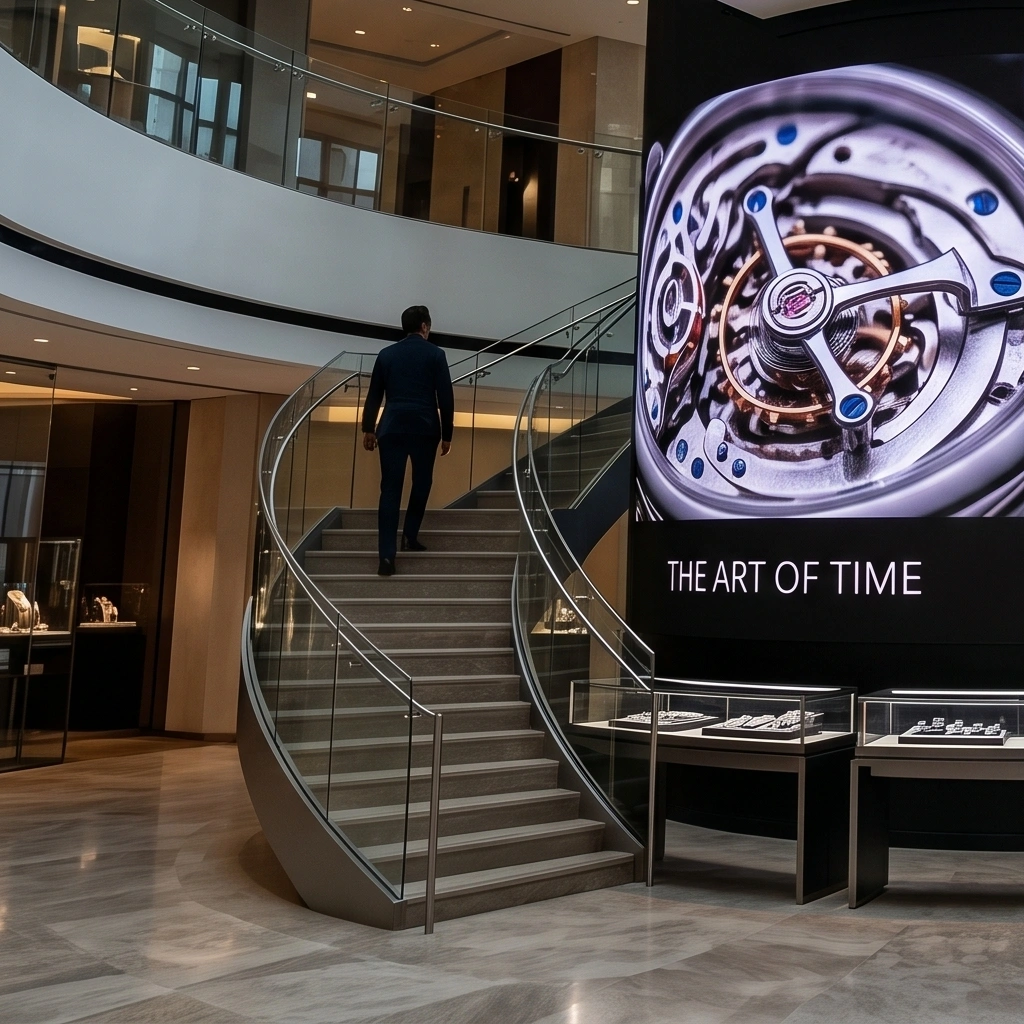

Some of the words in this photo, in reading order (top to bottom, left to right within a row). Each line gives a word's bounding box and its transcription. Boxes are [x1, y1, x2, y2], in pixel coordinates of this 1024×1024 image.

[667, 559, 708, 593] THE
[712, 559, 767, 594] ART
[774, 559, 820, 595] OF
[829, 560, 922, 596] TIME
